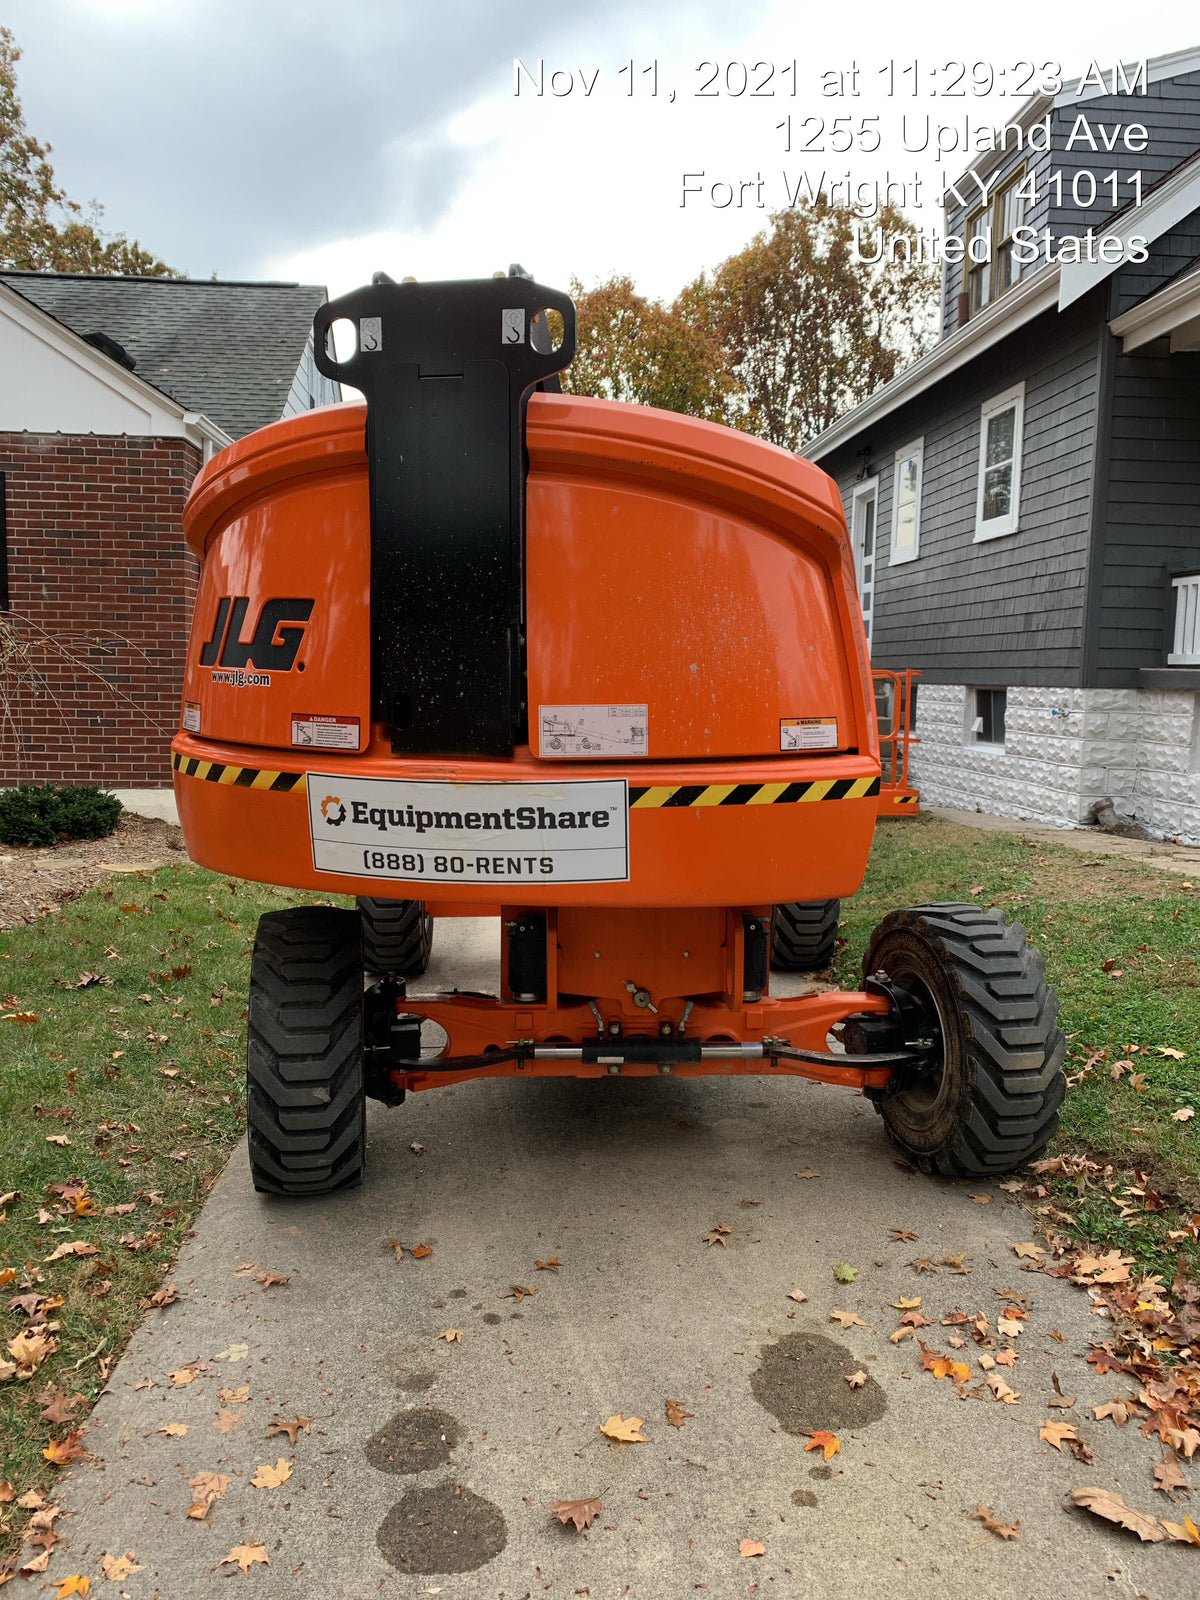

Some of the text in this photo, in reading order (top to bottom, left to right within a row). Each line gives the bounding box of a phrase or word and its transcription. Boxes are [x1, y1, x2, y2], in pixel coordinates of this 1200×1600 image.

[201, 597, 316, 671] JLG
[211, 671, 271, 686] www.jlg.com
[363, 850, 554, 875] (888) 80-RENTS
